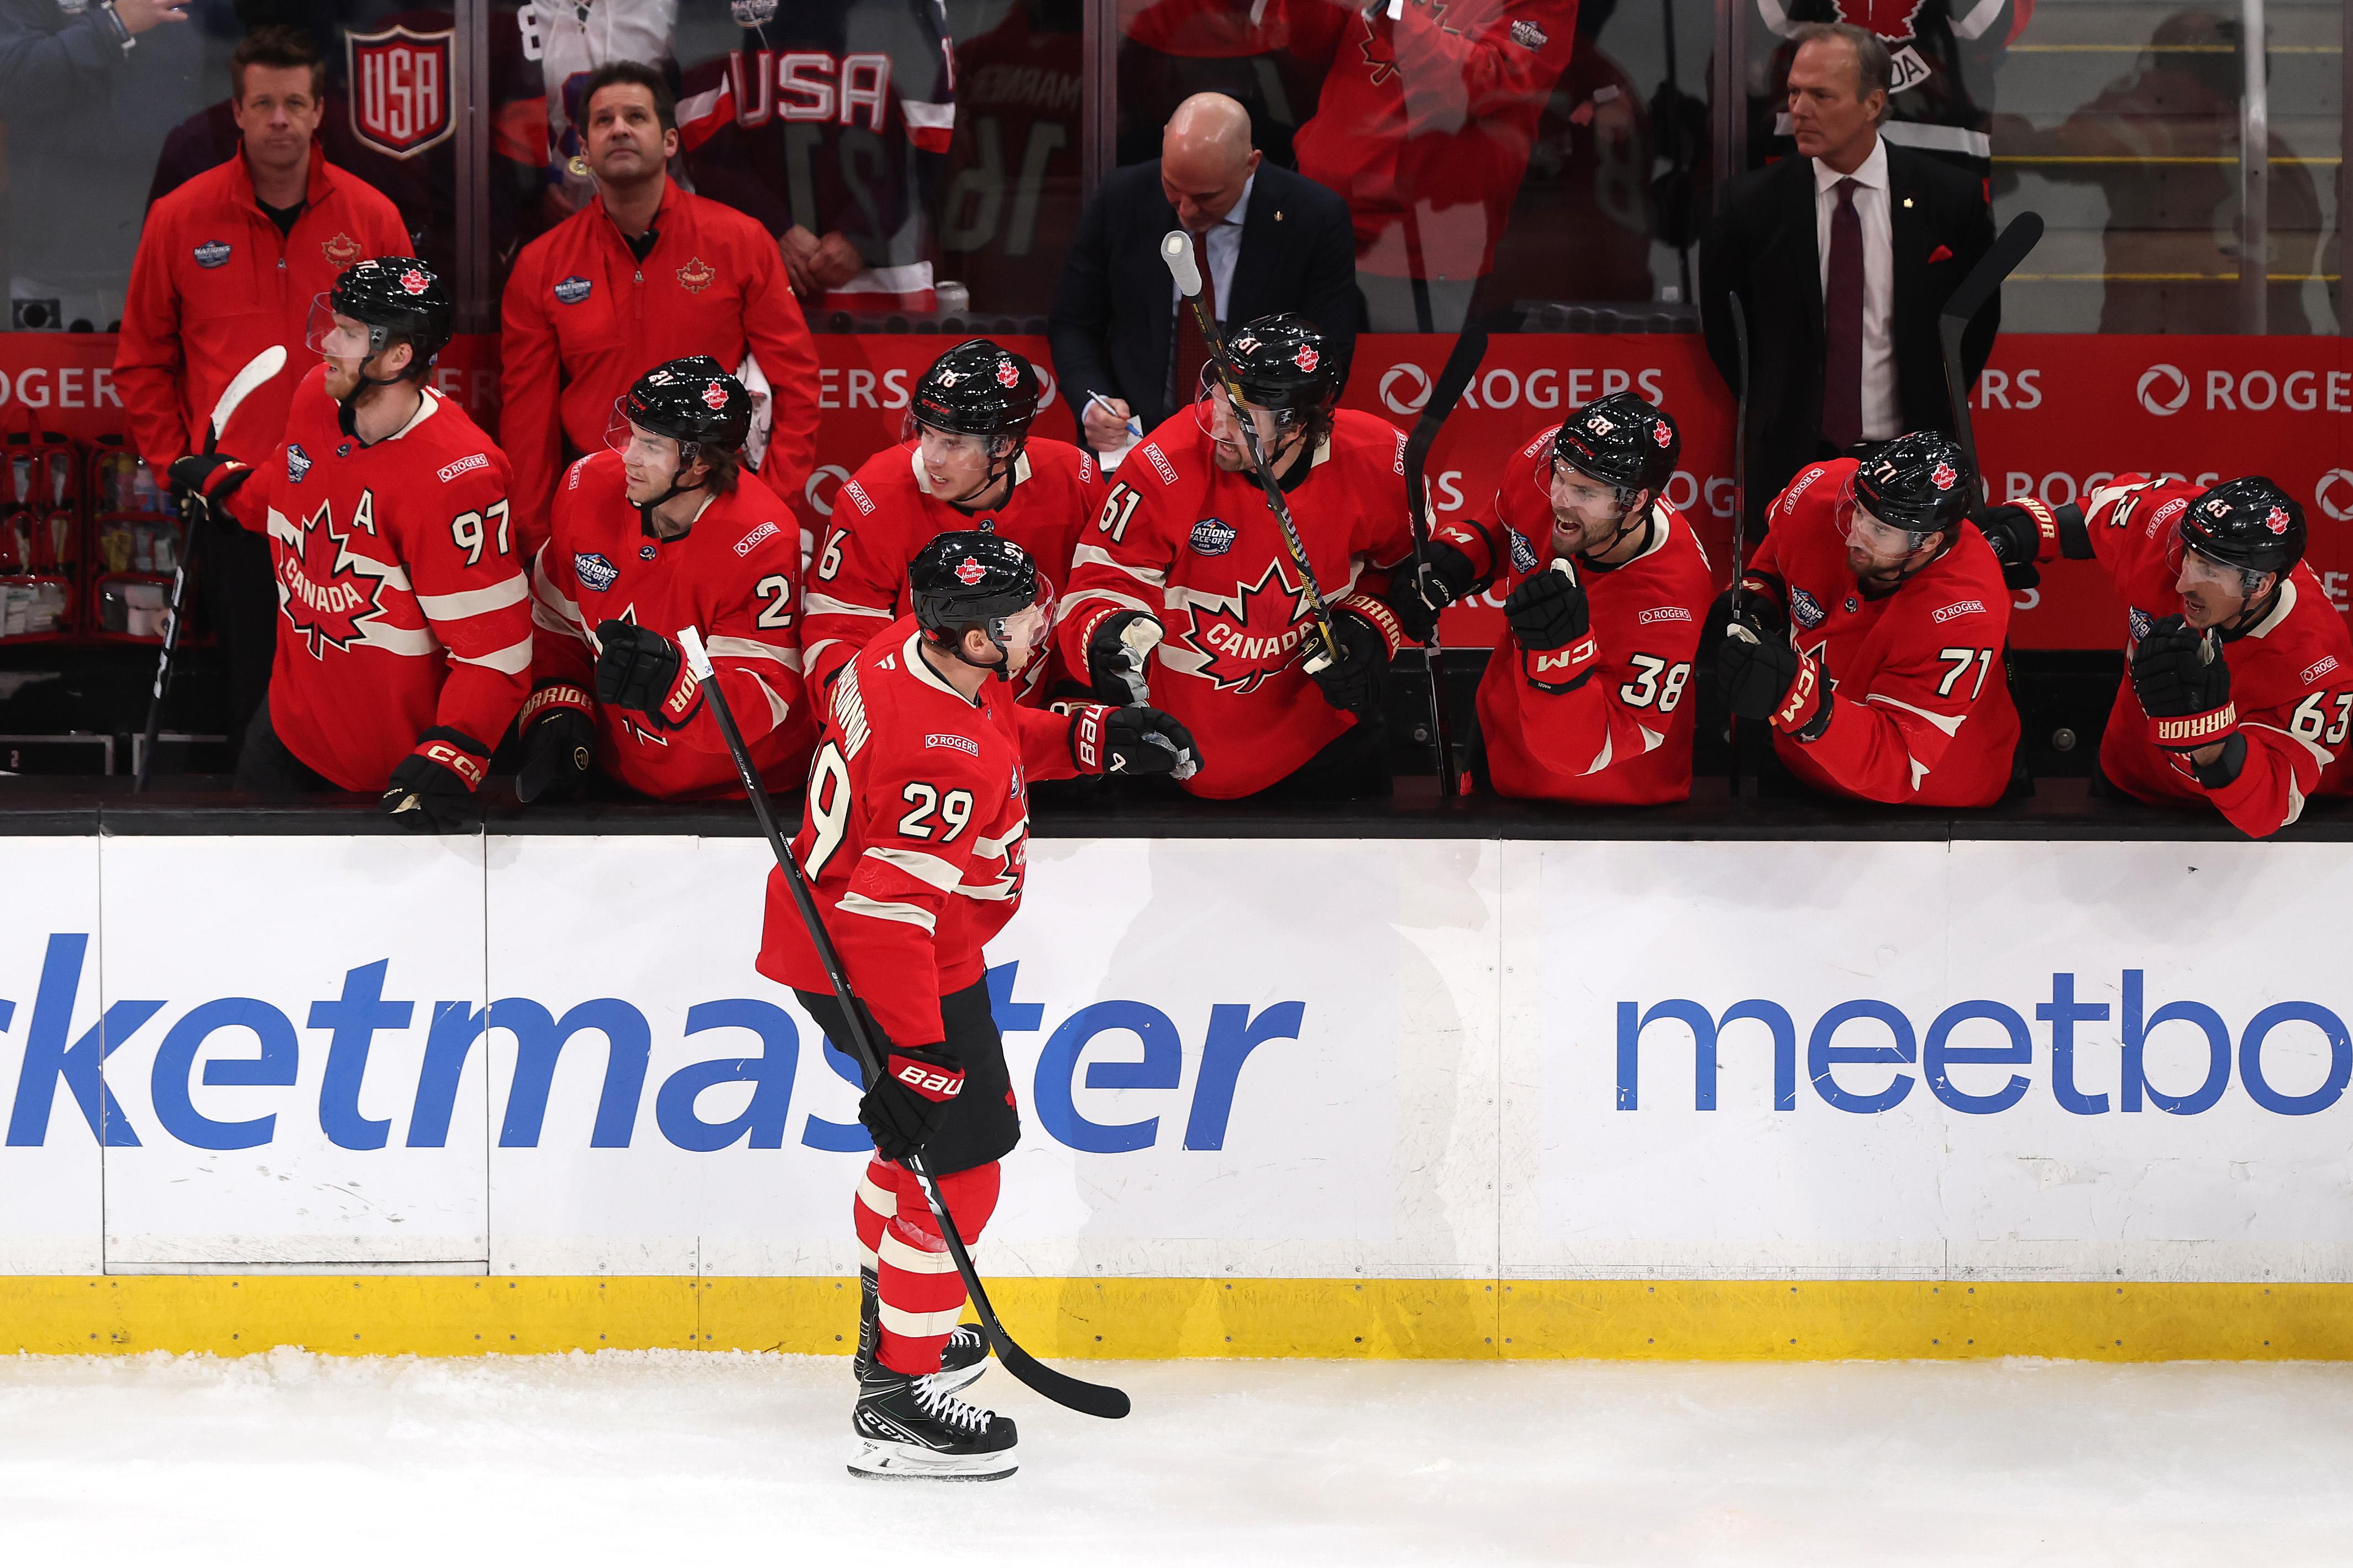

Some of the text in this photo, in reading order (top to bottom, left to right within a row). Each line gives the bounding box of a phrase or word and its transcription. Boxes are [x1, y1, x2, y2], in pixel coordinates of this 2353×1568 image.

[363, 47, 438, 139] USA
[730, 50, 892, 134] USA
[1238, 336, 1263, 356] 61
[0, 369, 124, 408] GER
[921, 398, 950, 414] CCM
[1587, 414, 1614, 436] 38
[452, 456, 486, 474] ROGERS
[1149, 446, 1175, 482] ROGERS
[1874, 460, 1898, 485] 71
[847, 482, 872, 513] ROGERS
[1785, 476, 1812, 512] ROGERS
[2207, 498, 2233, 518] 63
[352, 487, 377, 537] A
[1097, 480, 1143, 545] 61
[2147, 503, 2178, 536] ROGERS
[451, 498, 510, 568] 97
[575, 554, 618, 579] NATIONS
[285, 557, 364, 613] CANADA
[1432, 578, 1449, 602] CCM
[1654, 608, 1689, 619] ROGERS
[1948, 601, 1984, 617] ROGERS
[1206, 621, 1316, 660] CANADA
[1536, 638, 1598, 672] CM
[1538, 682, 1552, 691] HAGEL
[1620, 652, 1692, 713] 38
[1937, 646, 1994, 701] 71
[2158, 701, 2236, 739] WARRIOR
[2291, 689, 2353, 746] 63
[939, 736, 977, 755] ROGERS
[427, 745, 482, 785] CCM
[898, 780, 974, 843] 29
[779, 831, 794, 860] MACKINNON
[0, 932, 1306, 1154] ketmaster
[1616, 968, 2353, 1116] meetbo
[862, 1278, 879, 1290] CCM
[863, 1410, 914, 1444] CCM
[863, 1440, 880, 1451] TUK
